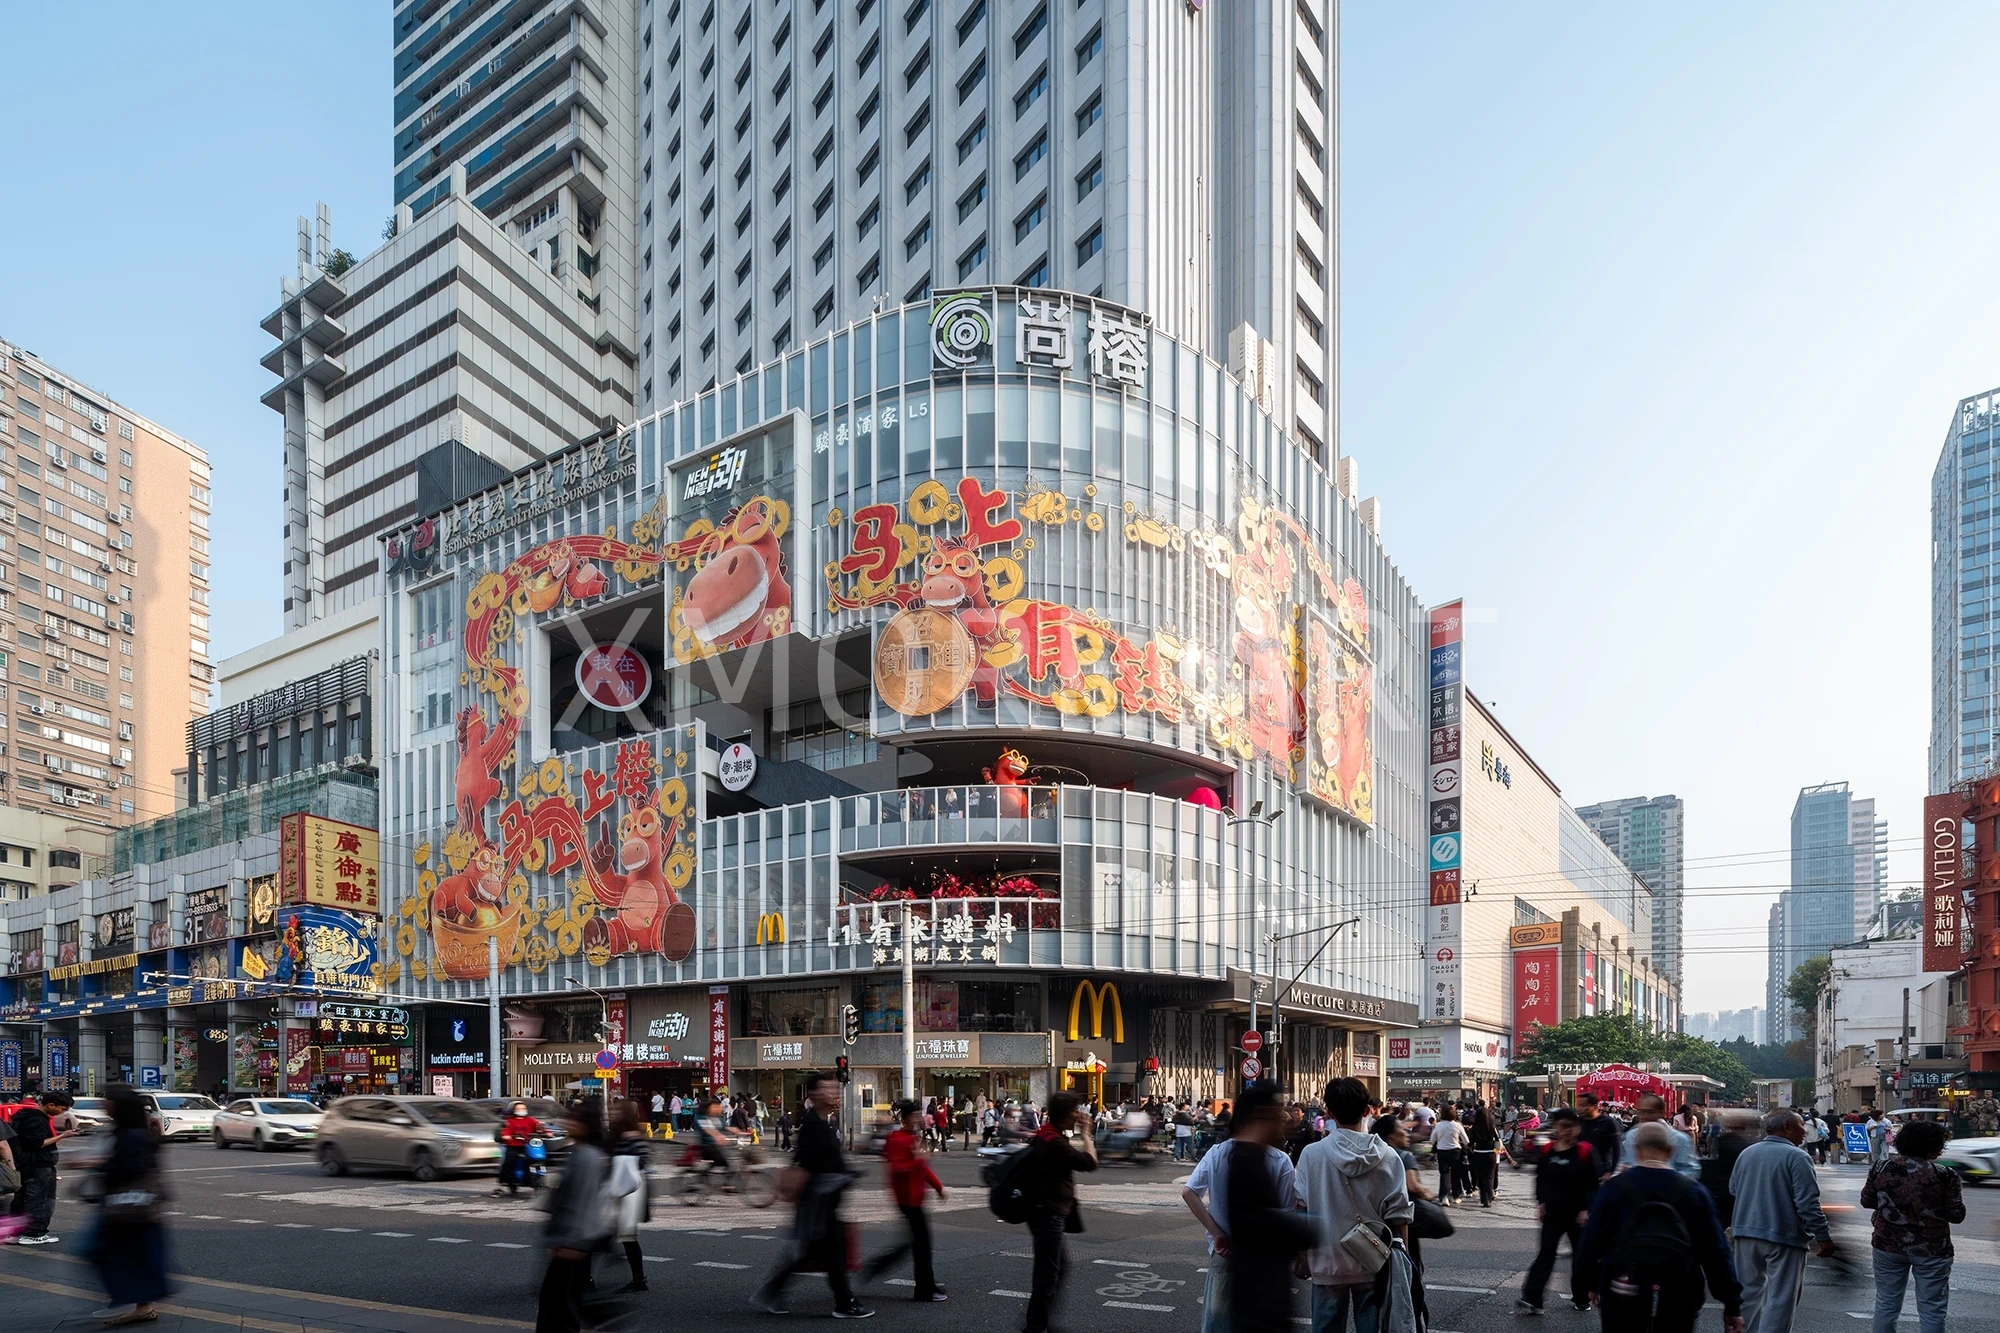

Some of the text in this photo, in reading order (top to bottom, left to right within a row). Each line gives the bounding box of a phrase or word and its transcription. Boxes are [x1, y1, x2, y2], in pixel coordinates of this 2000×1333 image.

[1017, 299, 1149, 388] 尚榕
[909, 402, 928, 418] L5
[443, 532, 478, 557] BEIJING
[478, 517, 506, 542] ROAD
[556, 480, 605, 508] TOURISM
[603, 462, 638, 488] ZONE
[840, 476, 1024, 582] 马上
[592, 655, 637, 674] 我在
[593, 679, 636, 699] 广州
[1431, 776, 1460, 786] スシロー
[1933, 817, 1956, 891] GOELIA
[334, 830, 363, 904] 廣御點
[1445, 871, 1457, 879] 24
[1934, 894, 1955, 948] 歌莉娅
[184, 917, 204, 945] 3F
[9, 950, 23, 974] 3F
[1430, 963, 1460, 971] CHAGEE
[1521, 960, 1541, 1010] 陶陶居
[1291, 987, 1344, 1011] Mercure
[335, 1006, 390, 1020] 旺角冰室
[650, 1019, 666, 1028] NEW
[649, 1045, 663, 1053] NEW
[762, 1042, 804, 1057] 六福珠寶
[915, 1039, 970, 1054] 六福珠寶
[1391, 1040, 1407, 1048] UNI
[344, 1051, 367, 1065] 便利店
[431, 1053, 452, 1064] luckin
[452, 1052, 474, 1064] coffee
[523, 1053, 554, 1066] MOLLY
[554, 1053, 574, 1065] TEA
[1391, 1048, 1409, 1057] QLO
